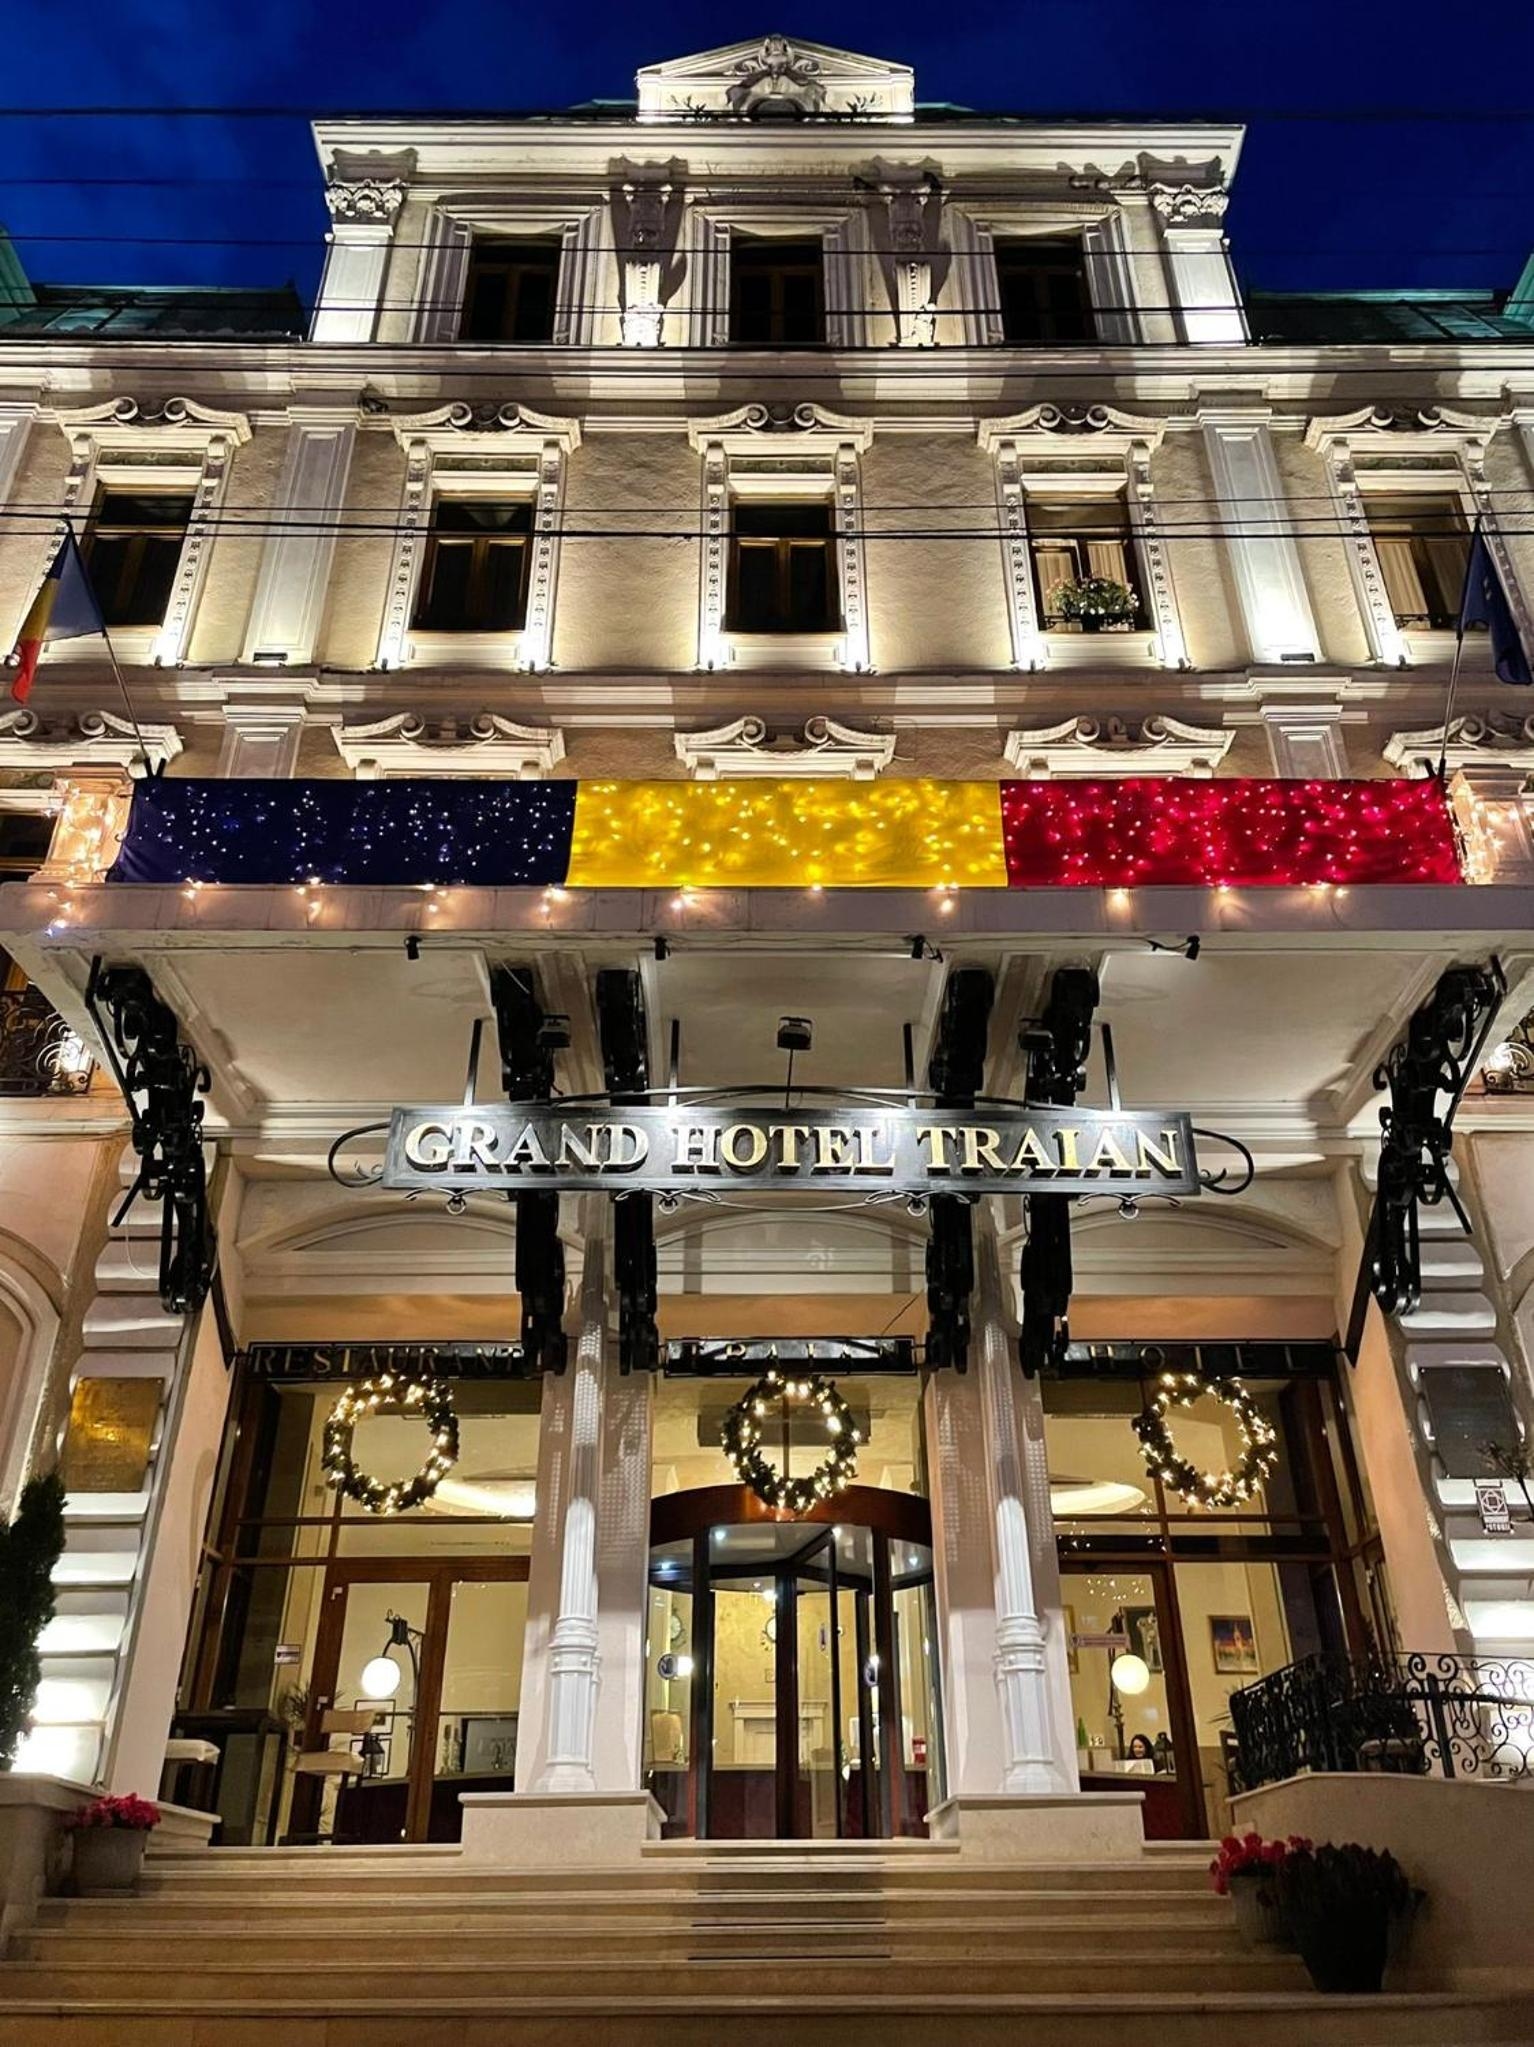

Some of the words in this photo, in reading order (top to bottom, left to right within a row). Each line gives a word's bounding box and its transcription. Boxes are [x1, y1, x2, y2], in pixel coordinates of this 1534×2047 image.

[404, 1120, 650, 1173] GRAND
[671, 1121, 897, 1176] HOTEL
[915, 1124, 1184, 1179] TRAIAN
[252, 1346, 526, 1374] RESTAURANT
